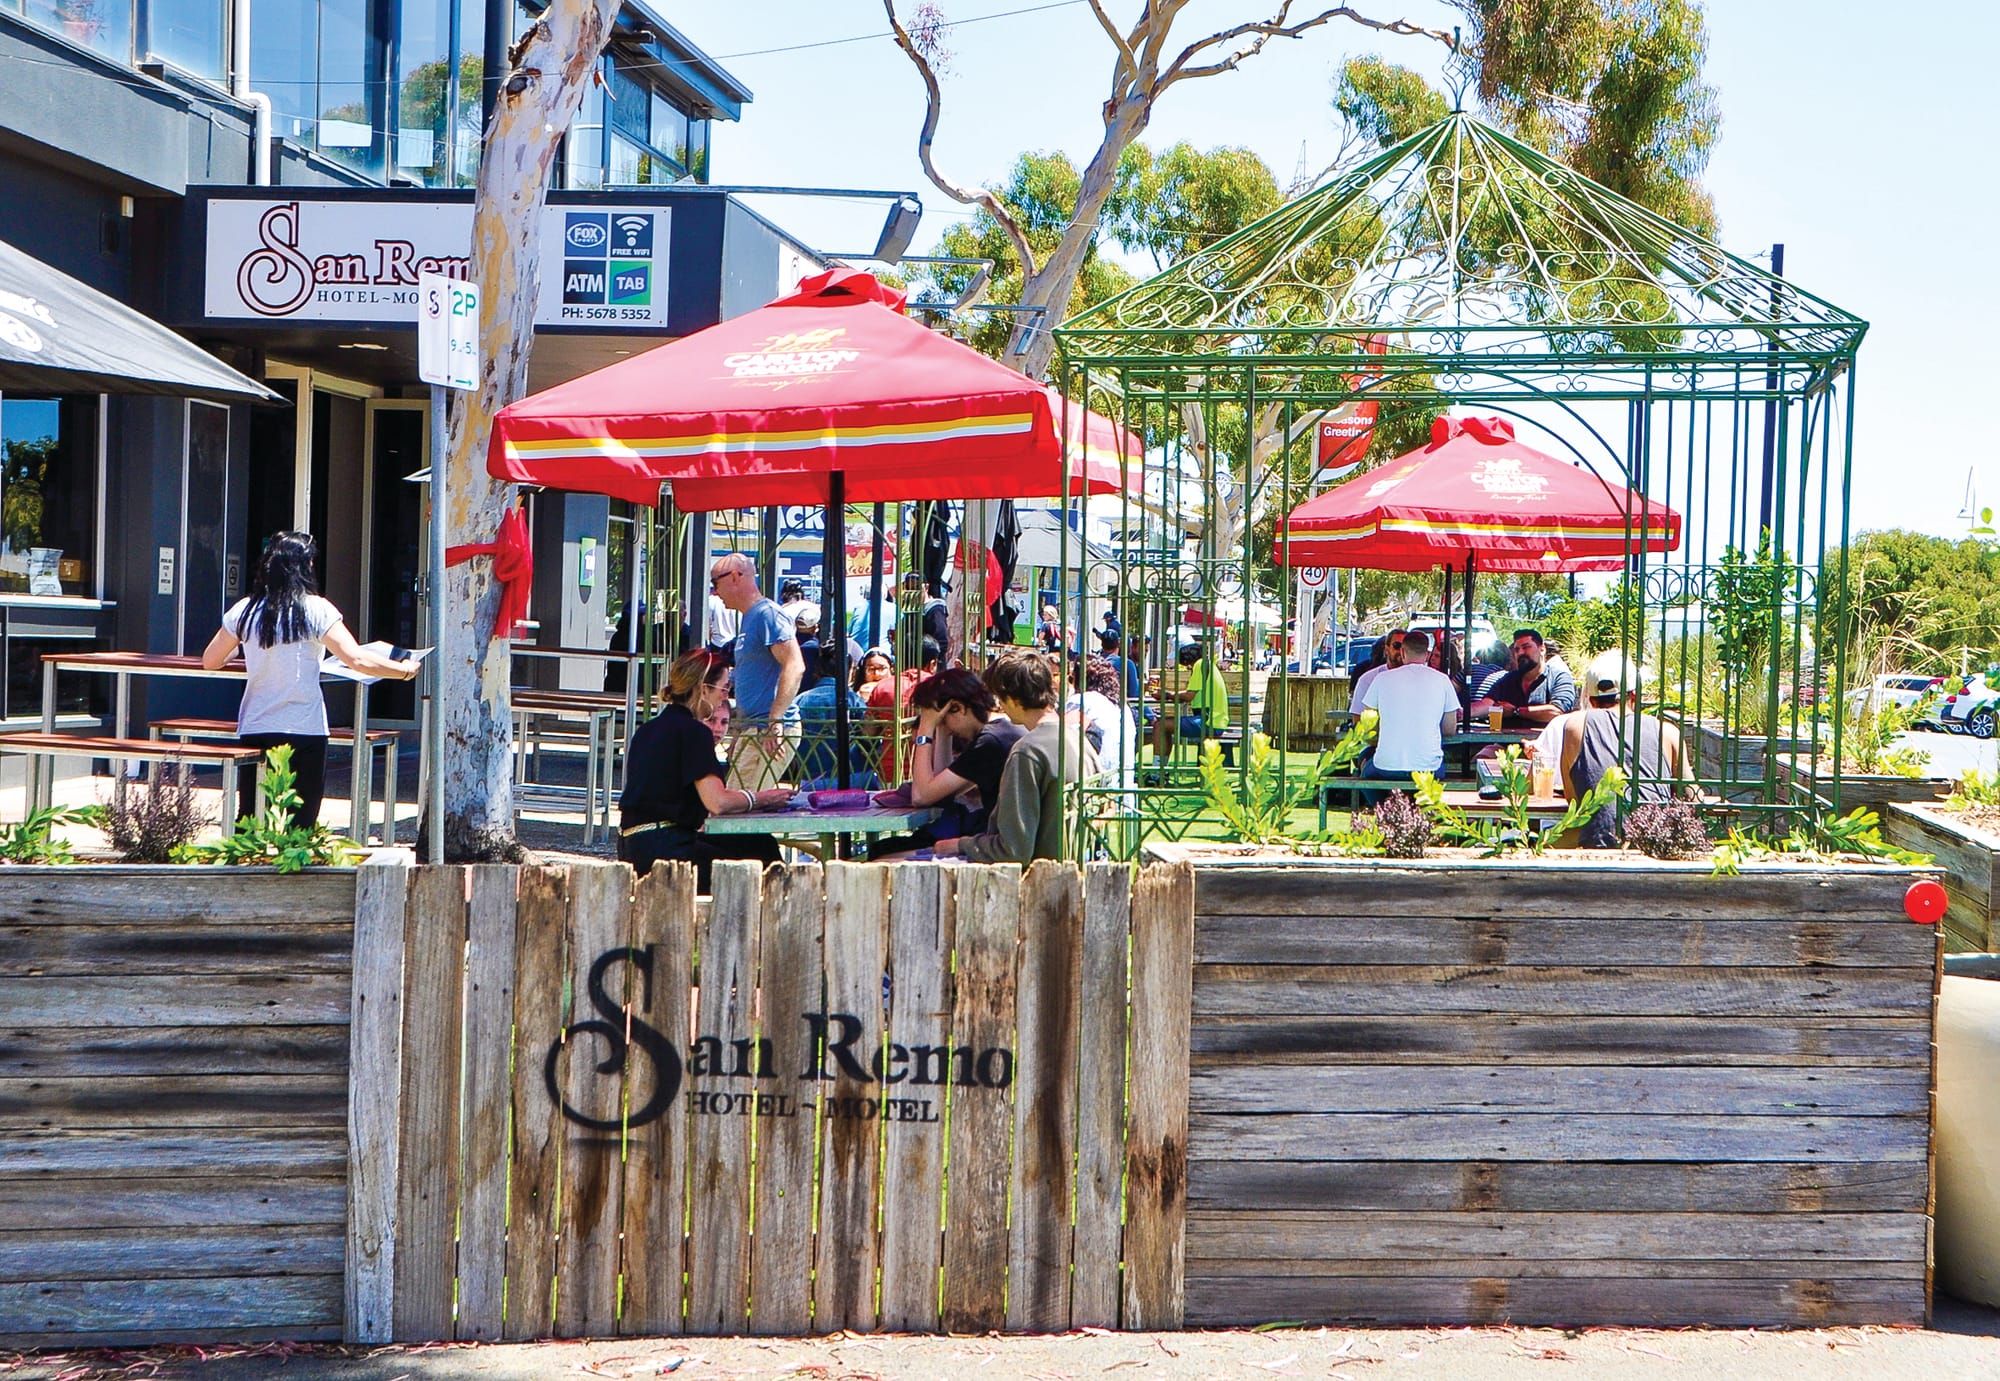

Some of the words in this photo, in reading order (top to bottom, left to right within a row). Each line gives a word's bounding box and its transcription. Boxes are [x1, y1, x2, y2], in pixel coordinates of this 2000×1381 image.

[574, 227, 598, 239] FOX
[237, 202, 369, 316] San
[373, 239, 471, 285] Rem
[612, 248, 632, 256] FREE
[565, 273, 604, 293] ATM
[615, 276, 645, 291] TAB
[452, 290, 477, 317] 2P
[561, 307, 584, 319] PH:
[585, 308, 617, 320] 5678
[620, 309, 652, 321] 5352
[723, 350, 860, 369] CARLTON
[1335, 415, 1374, 425] asons
[1305, 566, 1322, 578] 40
[544, 943, 777, 1131] San
[799, 1012, 1016, 1089] Remo
[686, 1091, 796, 1118] HOTEL
[825, 1097, 939, 1123] MOTEL
